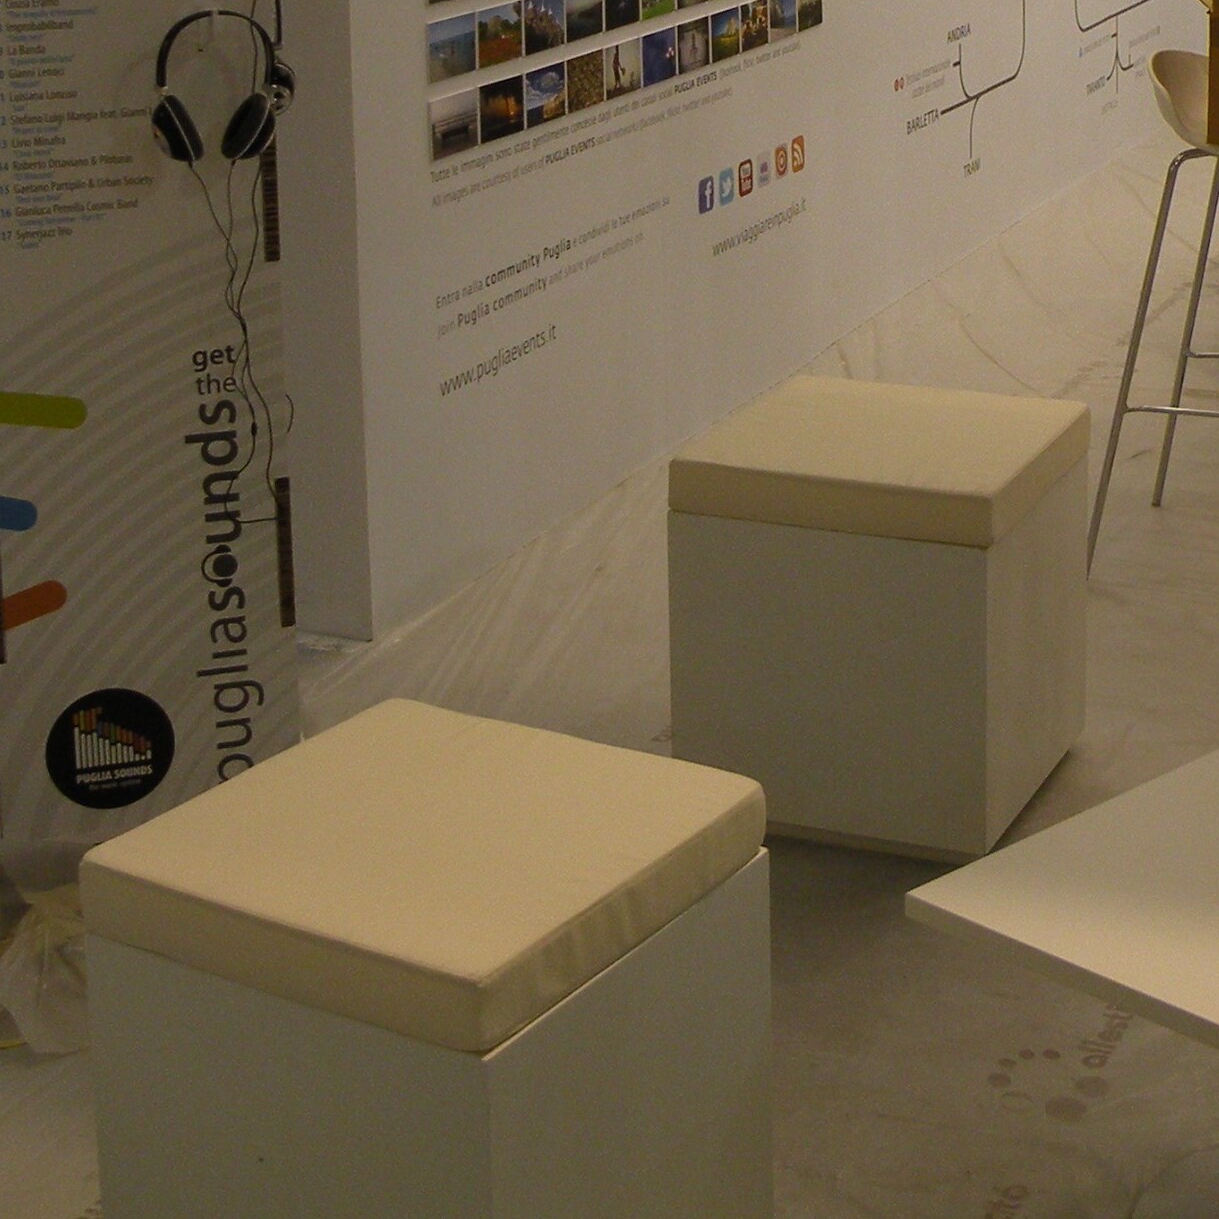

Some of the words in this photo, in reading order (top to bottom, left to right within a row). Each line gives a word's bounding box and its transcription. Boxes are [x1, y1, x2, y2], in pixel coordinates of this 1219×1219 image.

[485, 252, 539, 288] community
[543, 235, 570, 261] Puglia
[457, 299, 489, 331] Puglia
[492, 273, 546, 312] community
[191, 344, 236, 373] get
[440, 323, 557, 397] www.pugliaevents.it
[196, 374, 237, 395] the
[76, 769, 113, 785] PUGLIA
[114, 764, 153, 779] SOUNDS
